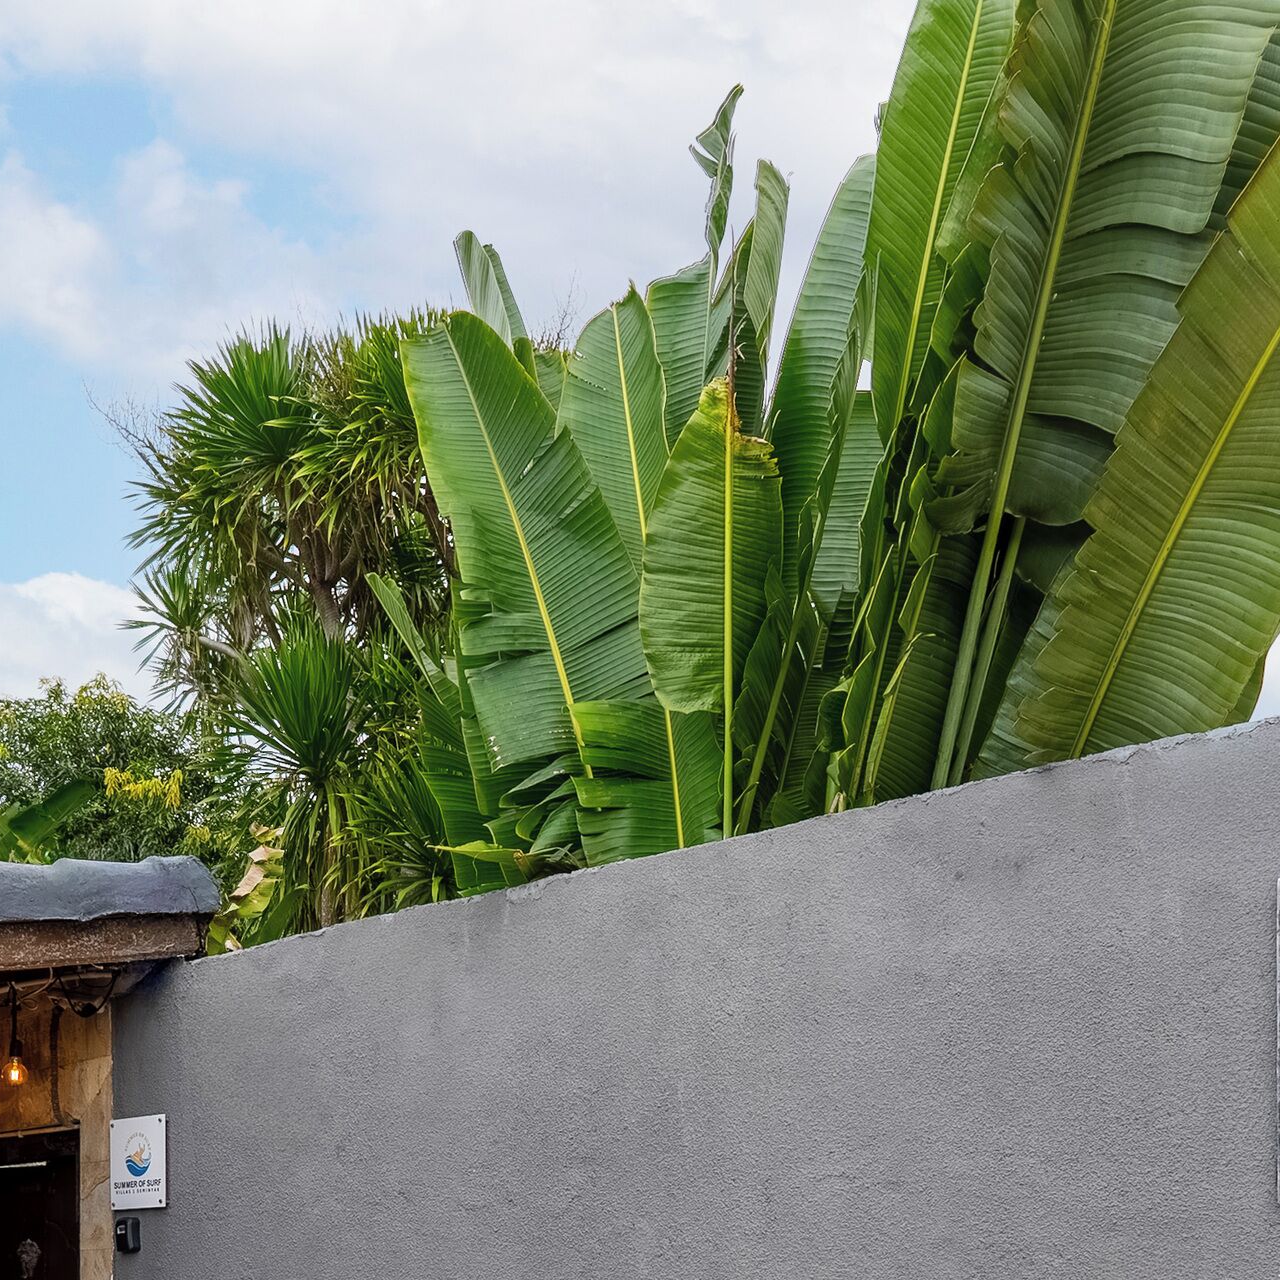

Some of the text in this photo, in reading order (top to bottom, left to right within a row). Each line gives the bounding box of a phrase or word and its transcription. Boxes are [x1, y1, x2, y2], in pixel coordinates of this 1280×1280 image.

[114, 1178, 161, 1189] SUMMER OF SURF
